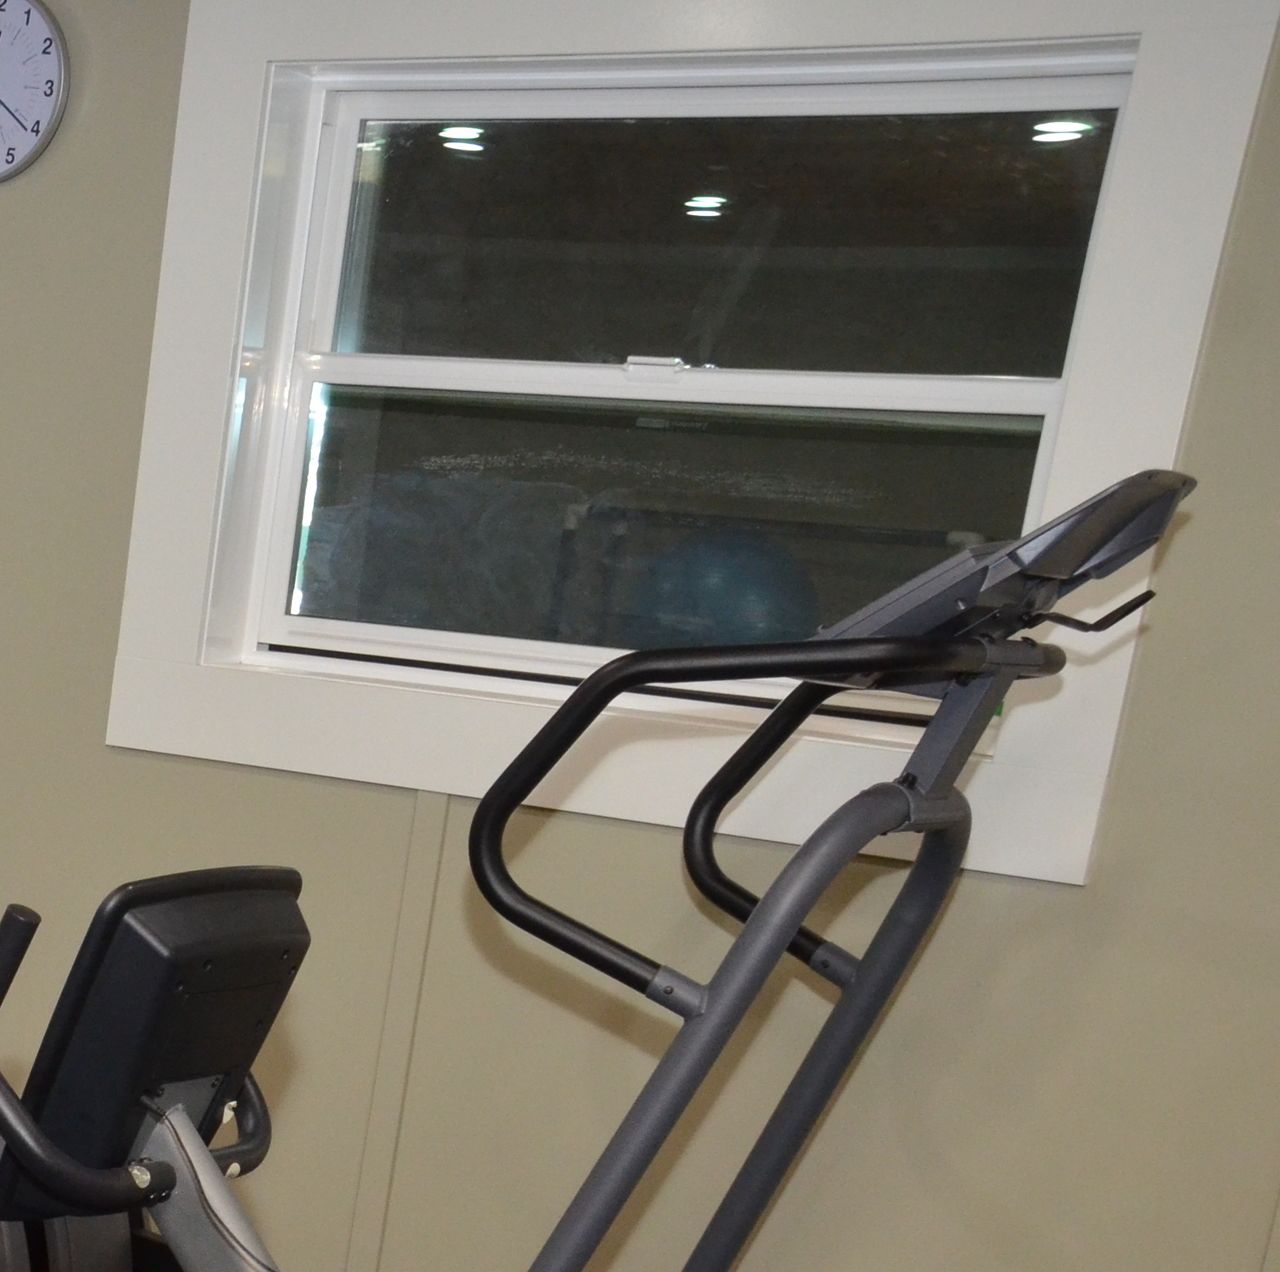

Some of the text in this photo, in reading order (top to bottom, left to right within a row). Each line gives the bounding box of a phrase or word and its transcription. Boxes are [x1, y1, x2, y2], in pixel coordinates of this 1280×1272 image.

[24, 9, 32, 26] 1
[42, 37, 53, 55] 2
[43, 80, 54, 97] 3
[31, 120, 41, 137] 4
[5, 148, 16, 164] 5
